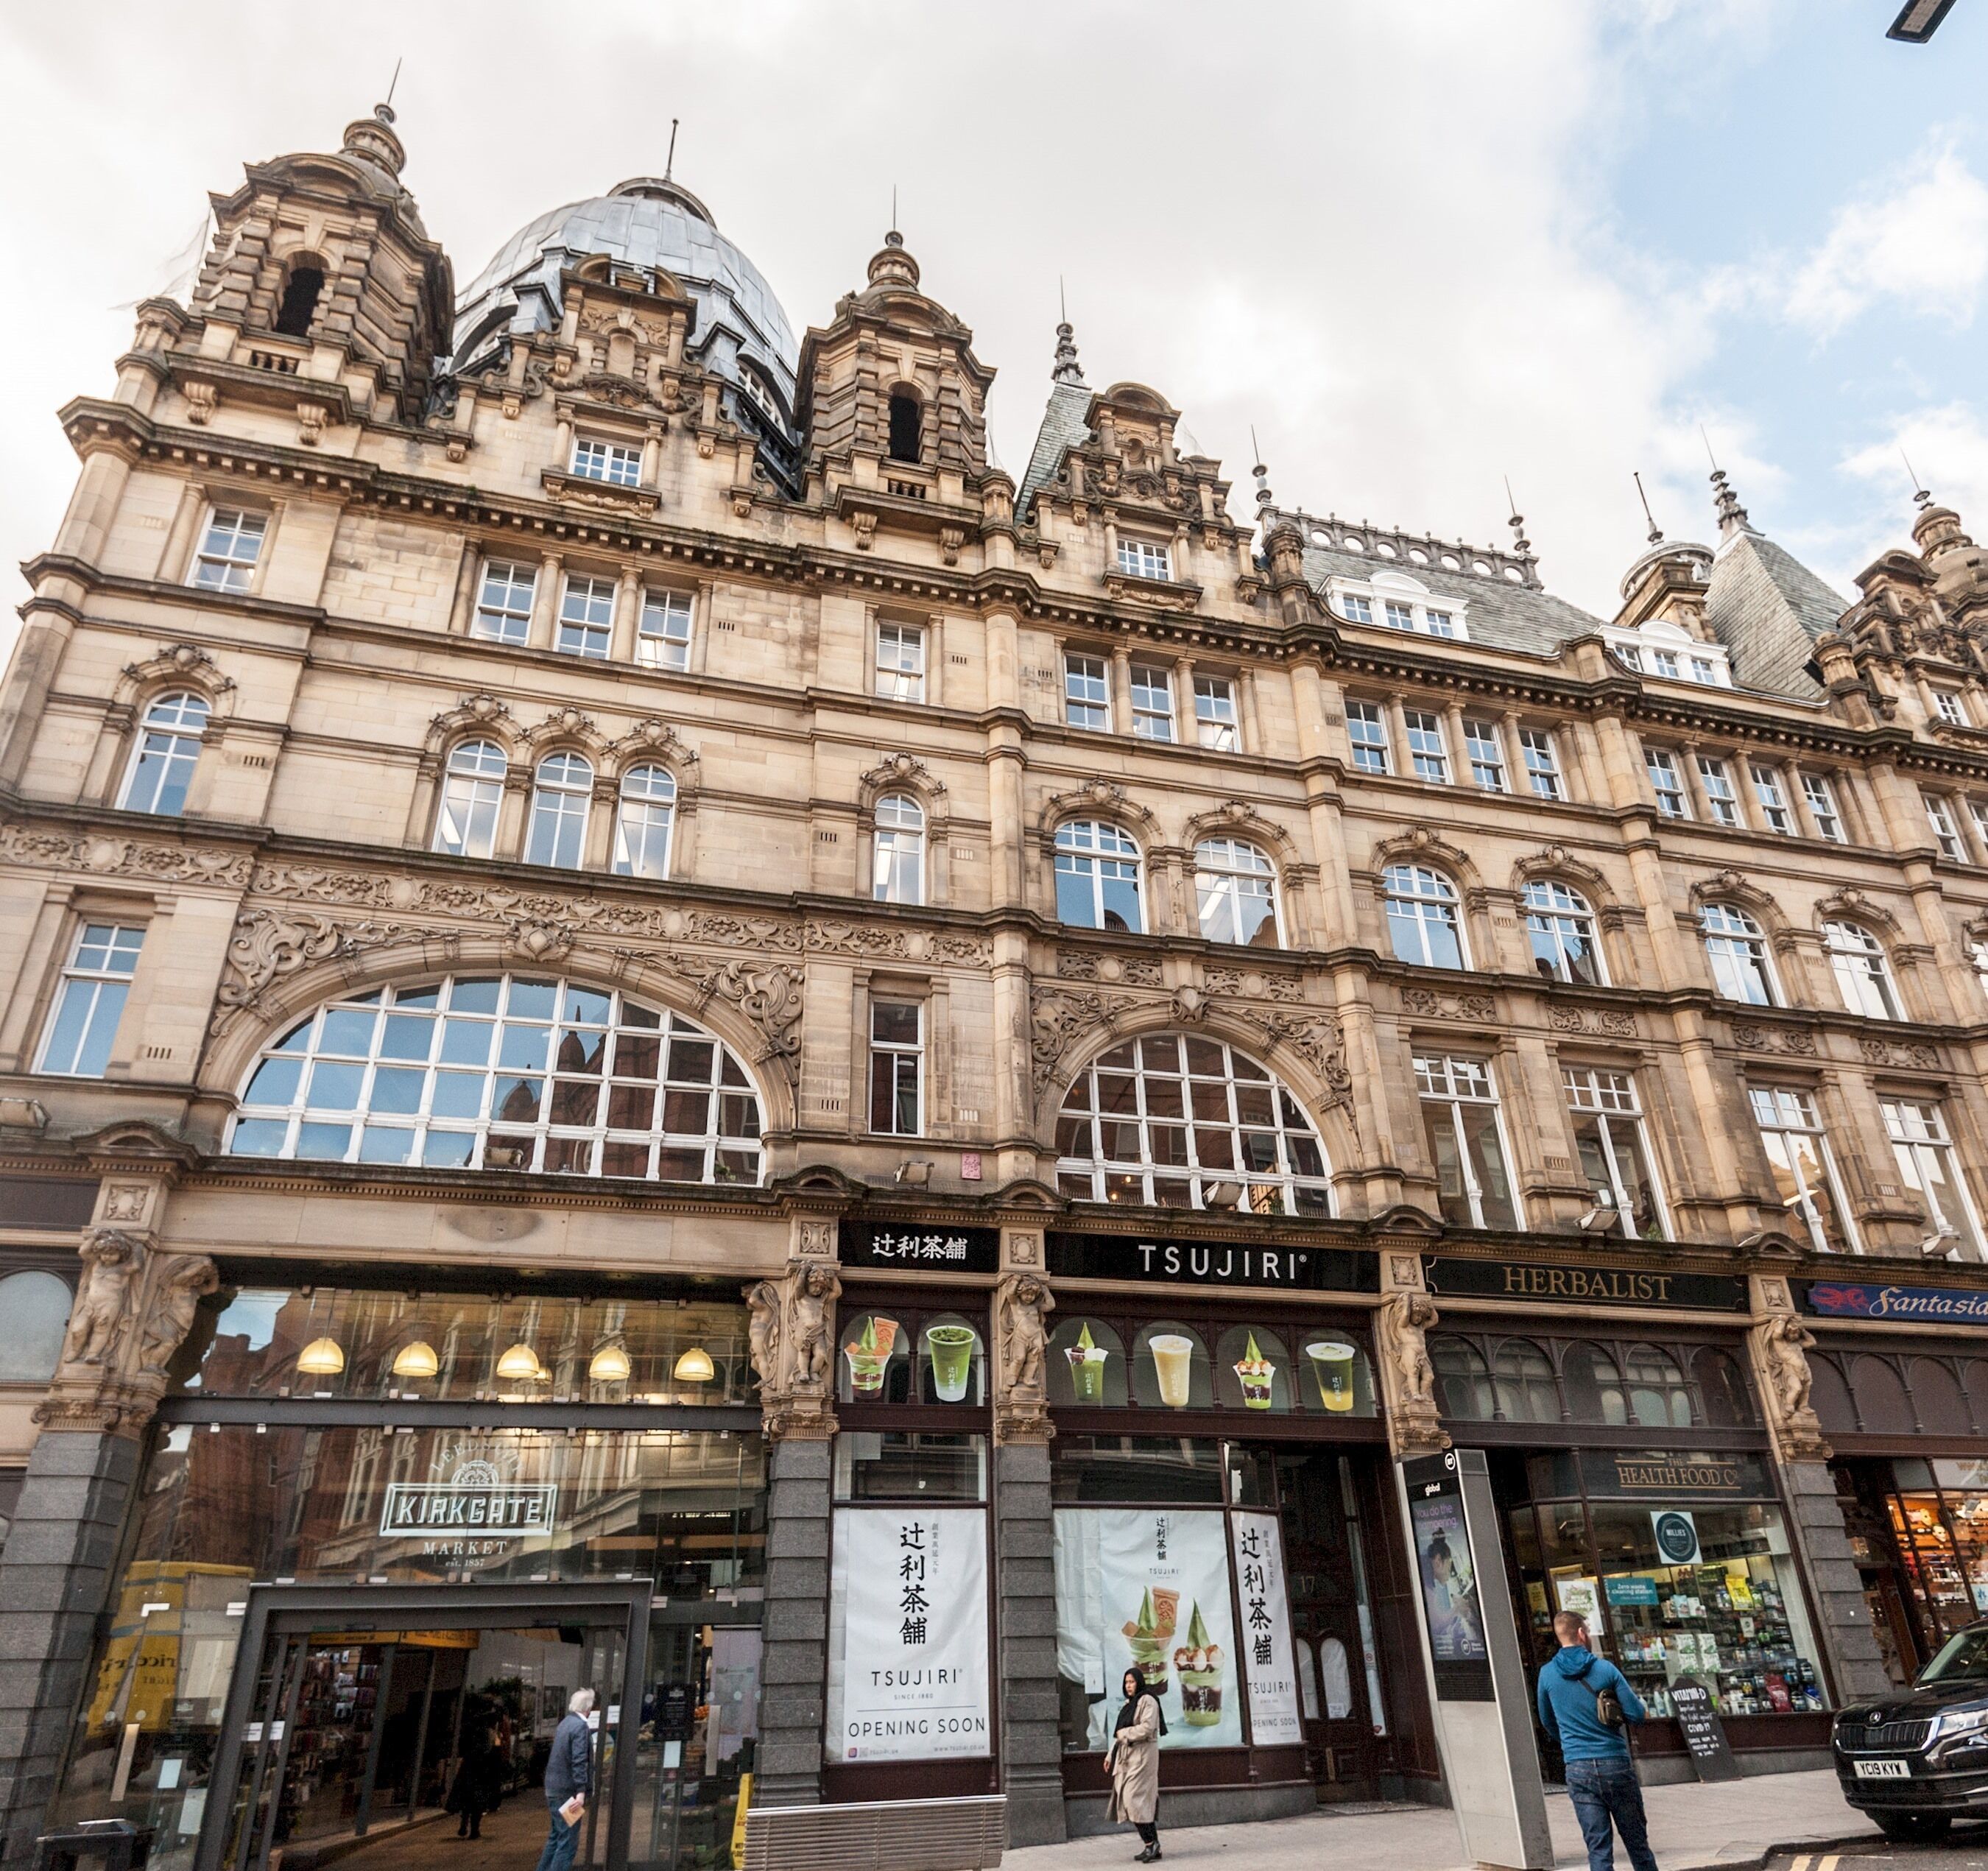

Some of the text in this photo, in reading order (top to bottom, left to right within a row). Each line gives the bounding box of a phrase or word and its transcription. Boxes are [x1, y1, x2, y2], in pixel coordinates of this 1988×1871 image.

[1503, 1266, 1672, 1300] HERBALIST
[431, 1439, 490, 1472] LEEDS
[1617, 1467, 1678, 1484] HEALTH
[1679, 1467, 1720, 1485] FOOD
[1425, 1482, 1441, 1496] global
[395, 1495, 543, 1524] KIRKGATE
[1414, 1504, 1453, 1518] You do the
[423, 1540, 507, 1555] MARKET
[465, 1557, 485, 1567] 1857
[1300, 1576, 1315, 1593] 17
[848, 1717, 985, 1738] OPENING SOON
[1253, 1718, 1277, 1727] PENING
[1859, 1761, 1903, 1775] YC19 KYW
